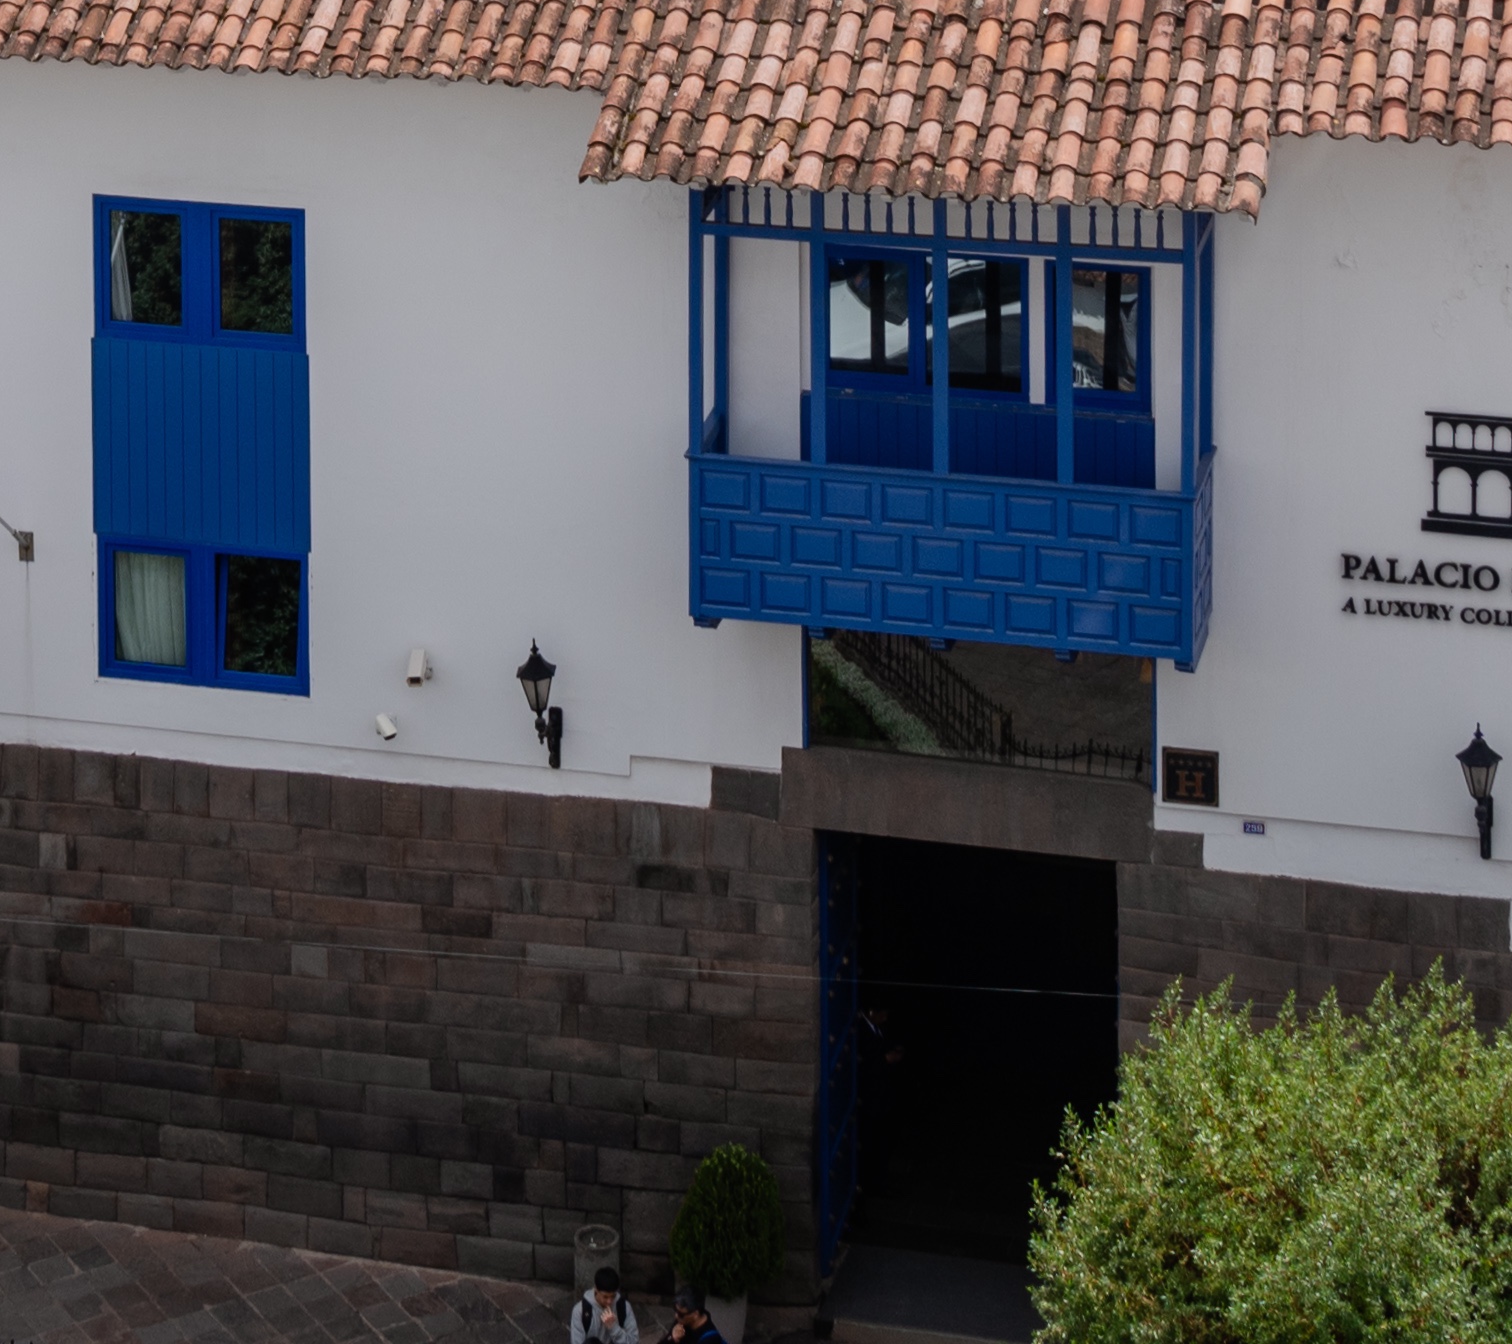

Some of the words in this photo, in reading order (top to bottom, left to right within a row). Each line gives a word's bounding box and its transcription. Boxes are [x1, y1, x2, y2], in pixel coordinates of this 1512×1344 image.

[1340, 553, 1500, 592] PALACIO
[1341, 597, 1357, 614] A
[1364, 598, 1454, 621] LUXURY
[1175, 769, 1206, 799] H
